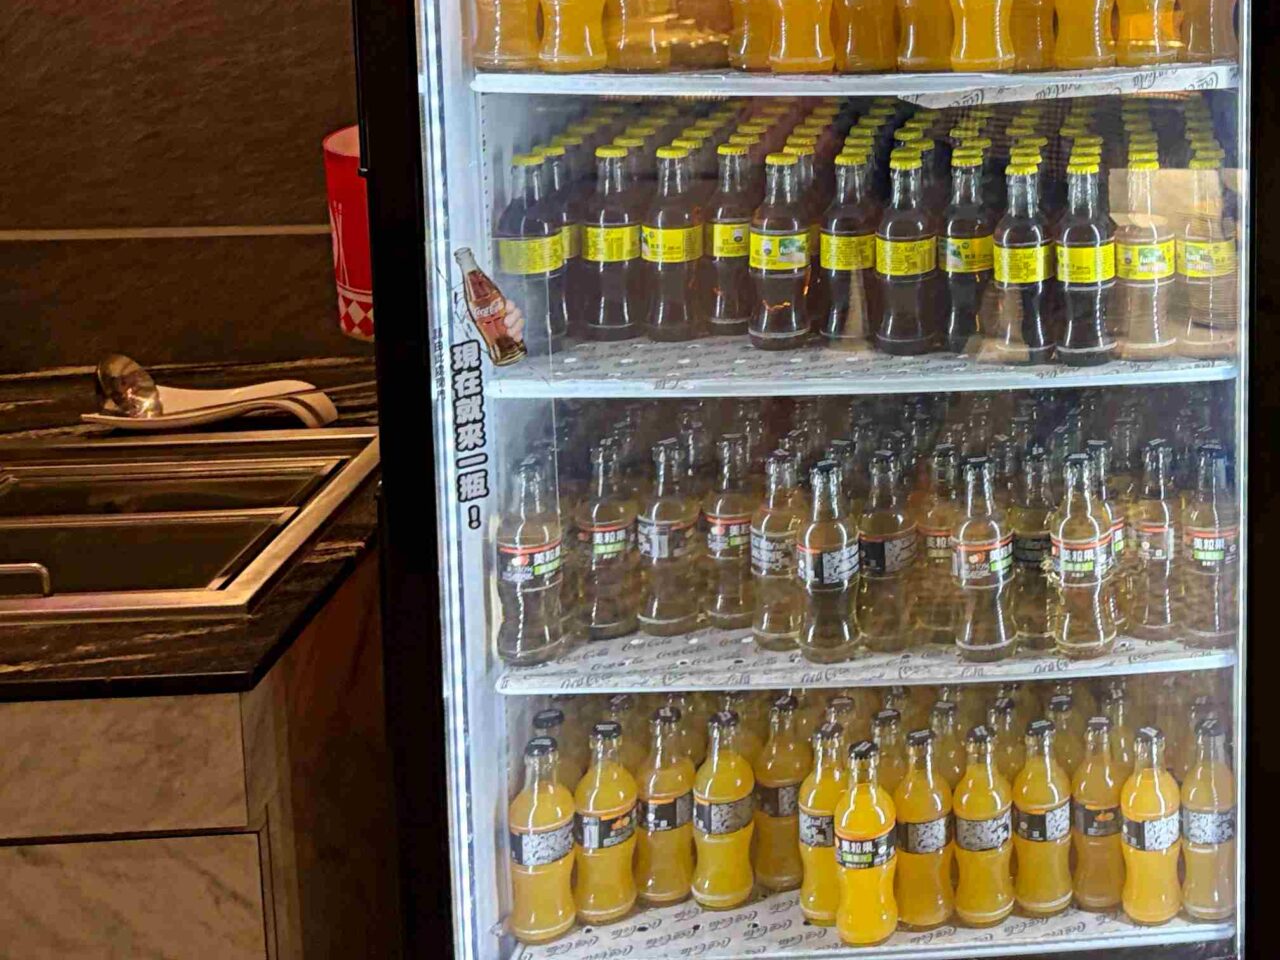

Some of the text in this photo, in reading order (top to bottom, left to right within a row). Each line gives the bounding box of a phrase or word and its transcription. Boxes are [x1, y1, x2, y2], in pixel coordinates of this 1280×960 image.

[450, 339, 488, 529] 現在就來一瓶!
[842, 840, 872, 853] 美粒果
